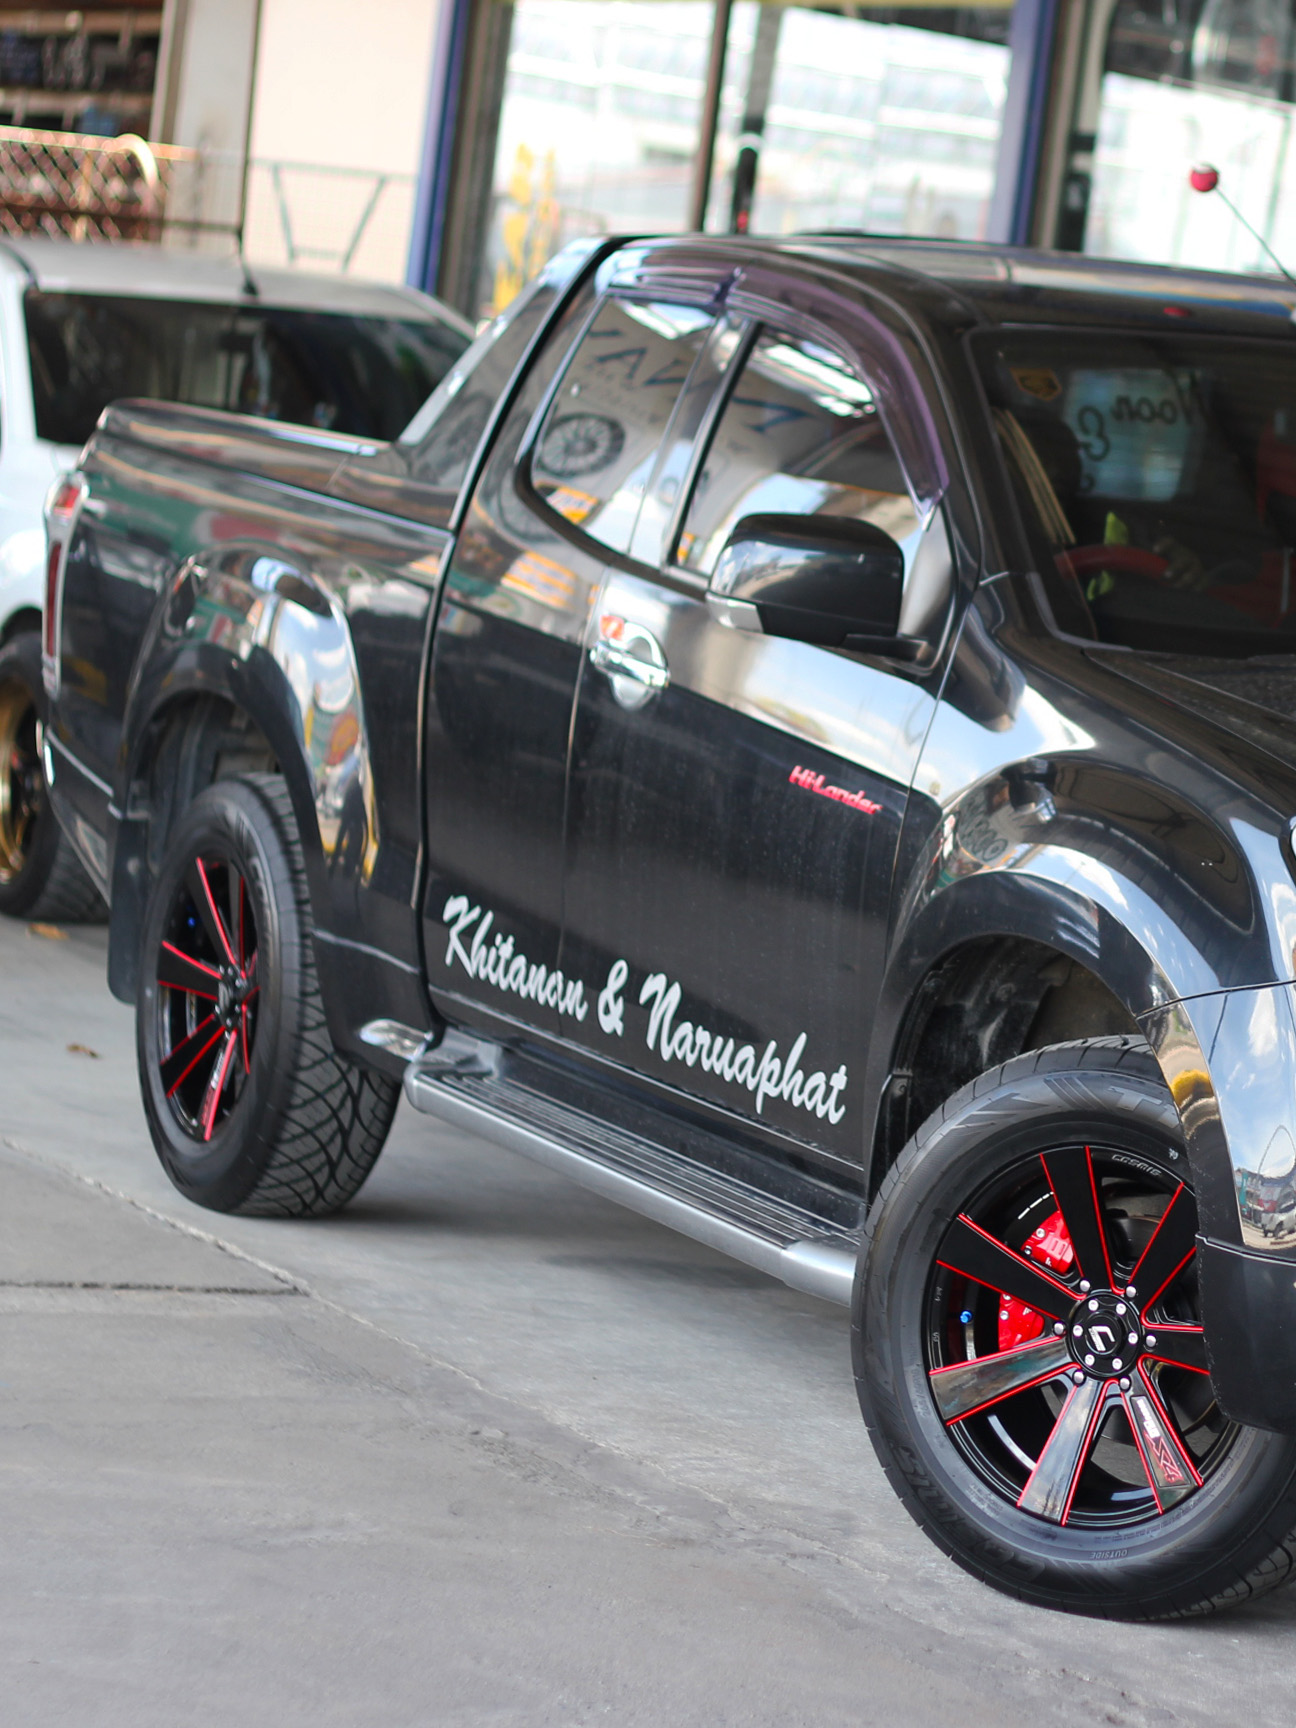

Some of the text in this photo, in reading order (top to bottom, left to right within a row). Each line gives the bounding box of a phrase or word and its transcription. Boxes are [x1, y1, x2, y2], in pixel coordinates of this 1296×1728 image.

[442, 895, 589, 1022] Khitanan
[597, 959, 630, 1037] &
[1089, 1548, 1129, 1560] OUTSIDE
